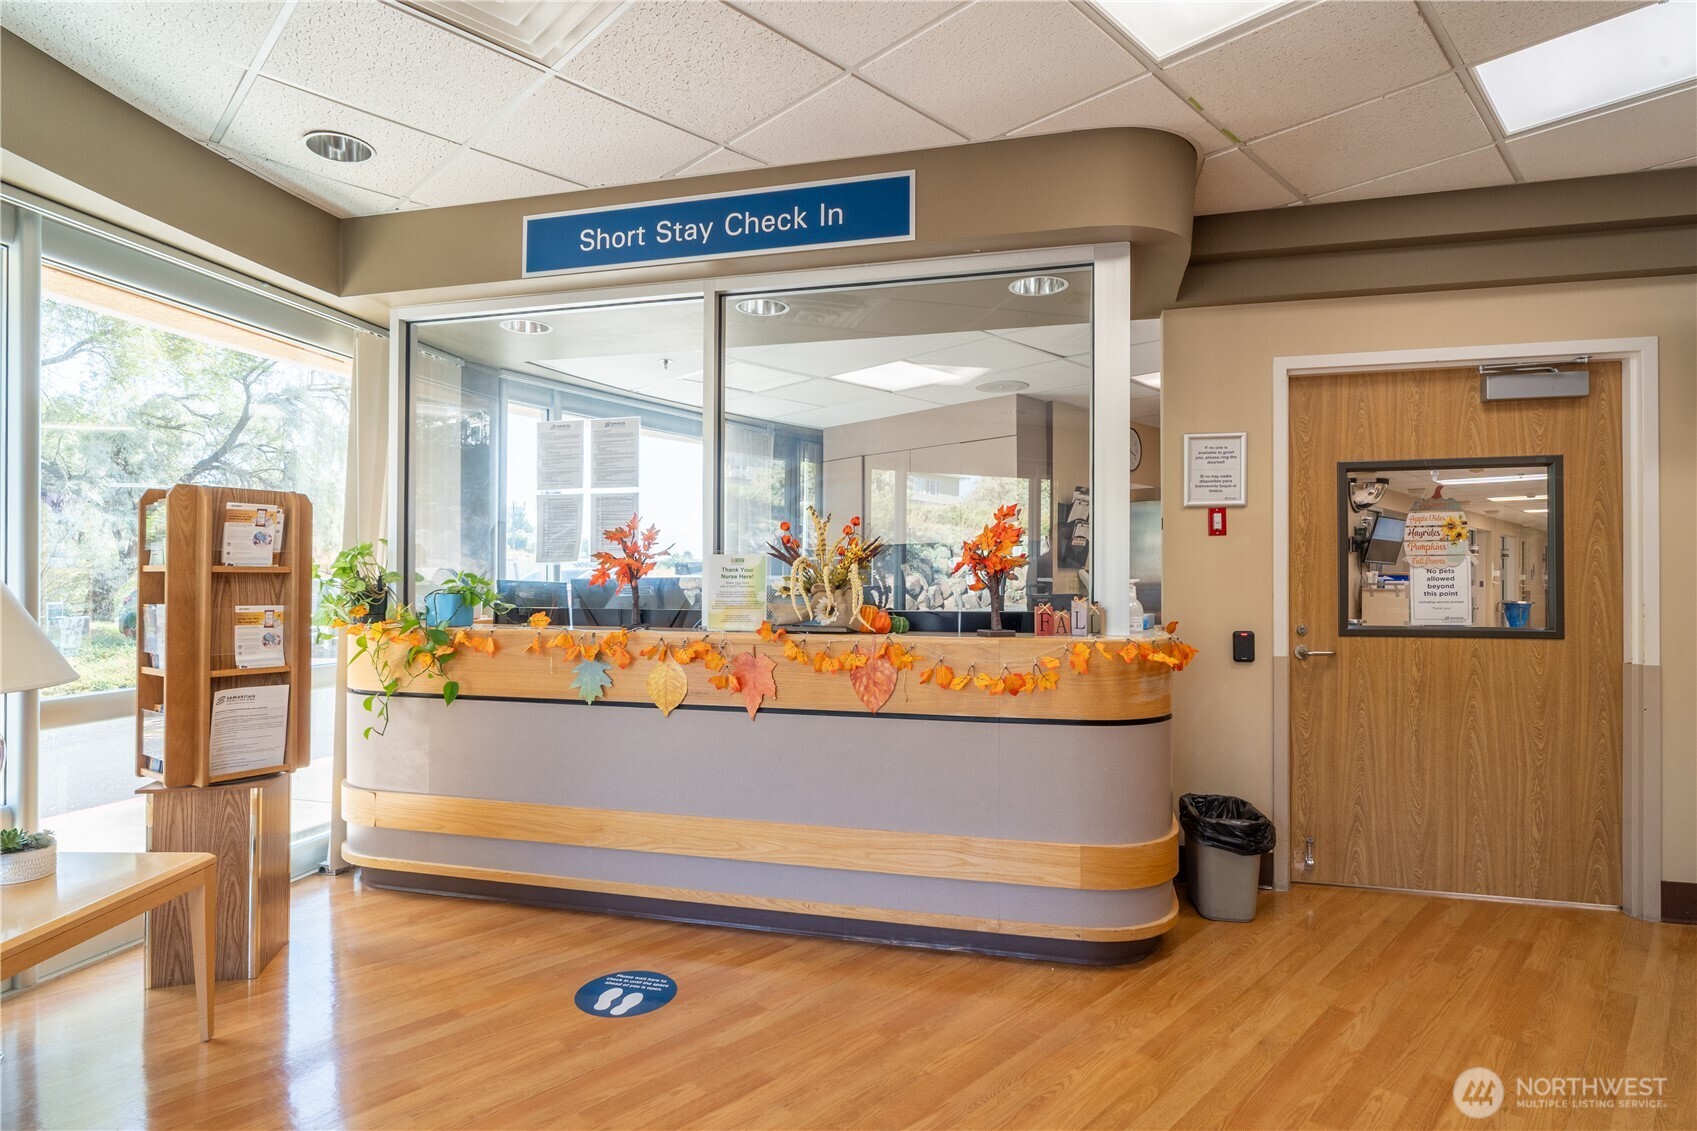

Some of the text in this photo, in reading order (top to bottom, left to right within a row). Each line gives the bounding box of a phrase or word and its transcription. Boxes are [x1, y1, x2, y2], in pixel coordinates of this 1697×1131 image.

[579, 203, 844, 252] Short Stay Check In
[1410, 514, 1428, 524] Apple
[1408, 528, 1441, 539] Hayrides
[1408, 542, 1446, 554] Pumpkins
[1040, 611, 1100, 634] FALL
